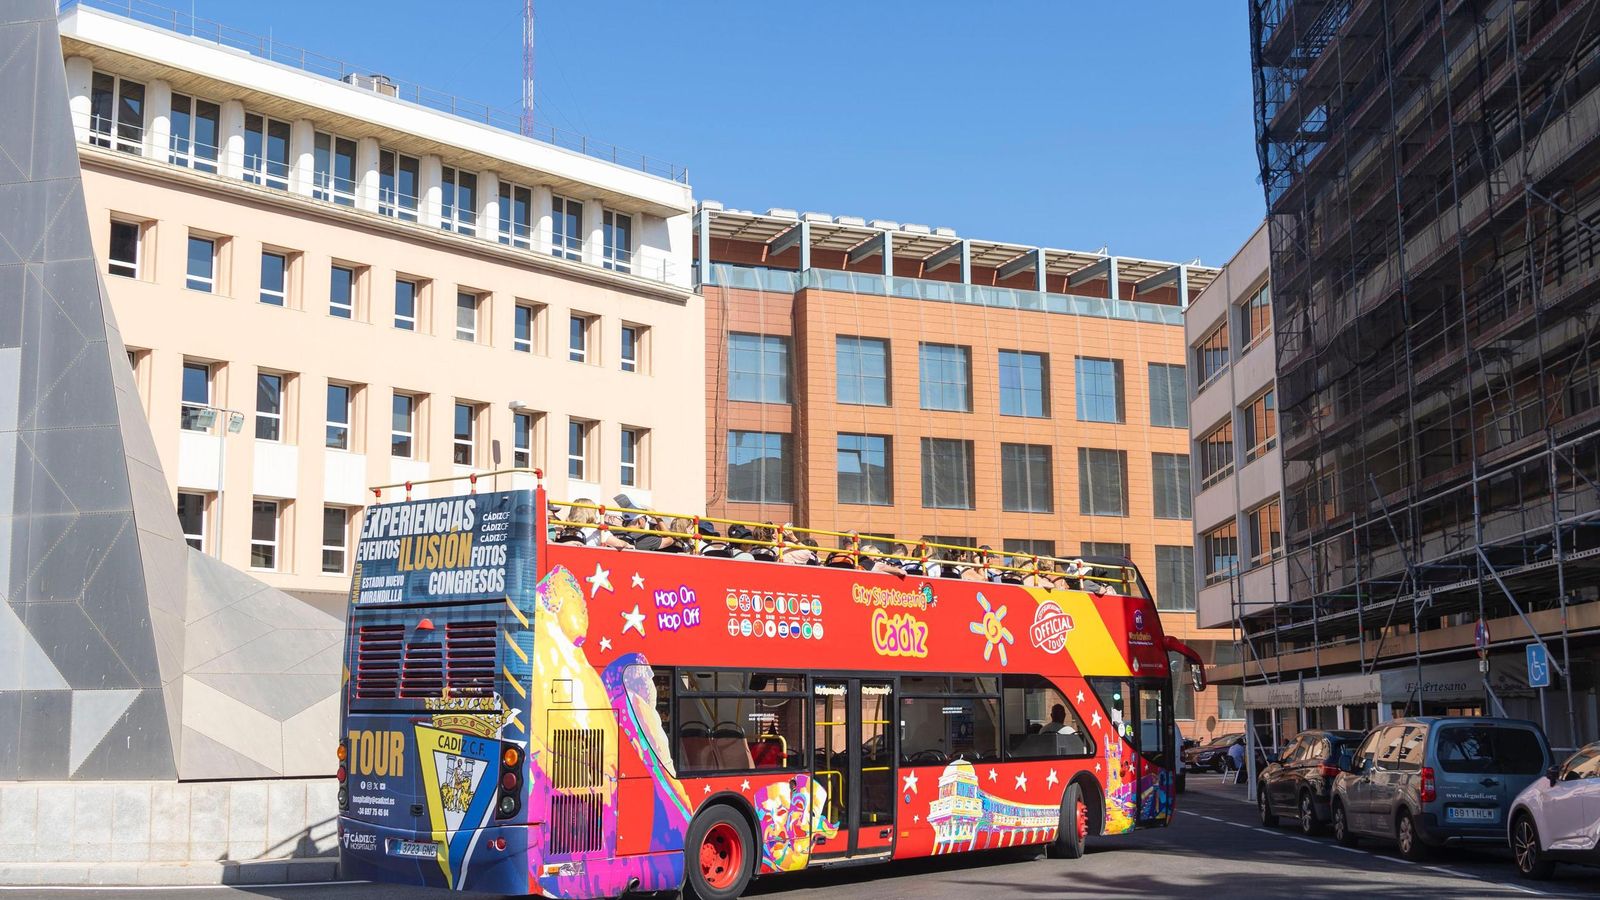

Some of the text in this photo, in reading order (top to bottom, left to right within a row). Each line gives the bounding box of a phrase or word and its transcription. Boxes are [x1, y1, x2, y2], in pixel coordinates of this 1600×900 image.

[361, 499, 476, 538] EXPERIENCIAS
[357, 540, 400, 561] EVENTOS
[398, 526, 473, 571] ILUSIÓN
[470, 544, 507, 567] FOTOS
[362, 574, 404, 588] ESTADIO NUEVO
[428, 567, 506, 595] CONGRESOS
[654, 586, 696, 608] Hop On
[658, 607, 700, 631] Hop Off
[1034, 616, 1073, 643] OFFICIAL
[1048, 634, 1066, 650] TOUR
[349, 730, 404, 776] TOUR
[437, 734, 486, 757] CADIZ C.F.
[402, 843, 419, 855] 3723
